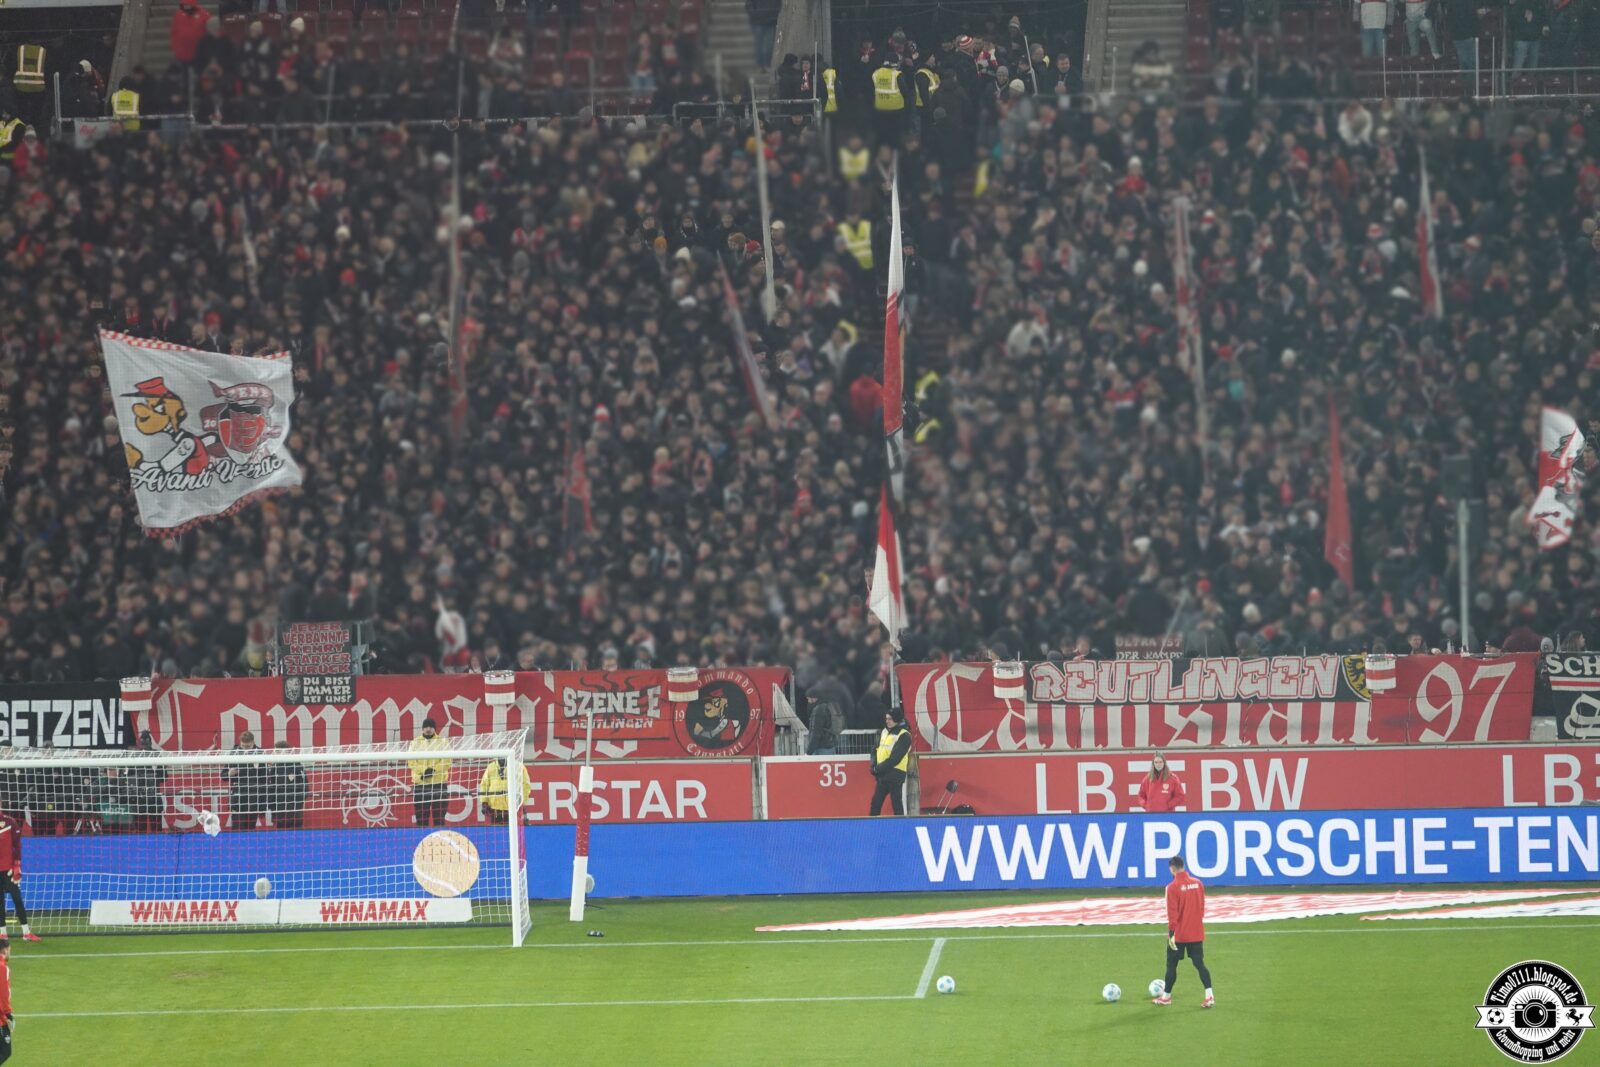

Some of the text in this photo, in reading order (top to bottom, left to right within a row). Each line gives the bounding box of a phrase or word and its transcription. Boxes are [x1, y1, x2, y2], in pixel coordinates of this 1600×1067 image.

[131, 464, 213, 492] Avanti
[283, 630, 349, 645] VERBANNTE
[290, 643, 345, 654] KEHRT
[1116, 651, 1140, 660] DER
[303, 677, 351, 685] DU BIST
[1031, 656, 1340, 703] REUTLINGEN
[303, 686, 351, 695] IMMER
[563, 687, 640, 718] SZENE
[1416, 661, 1516, 742] 97
[674, 708, 760, 722] 19 97
[819, 763, 847, 787] 35
[130, 901, 239, 922] WINAMAX
[319, 900, 429, 922] WINAMAX
